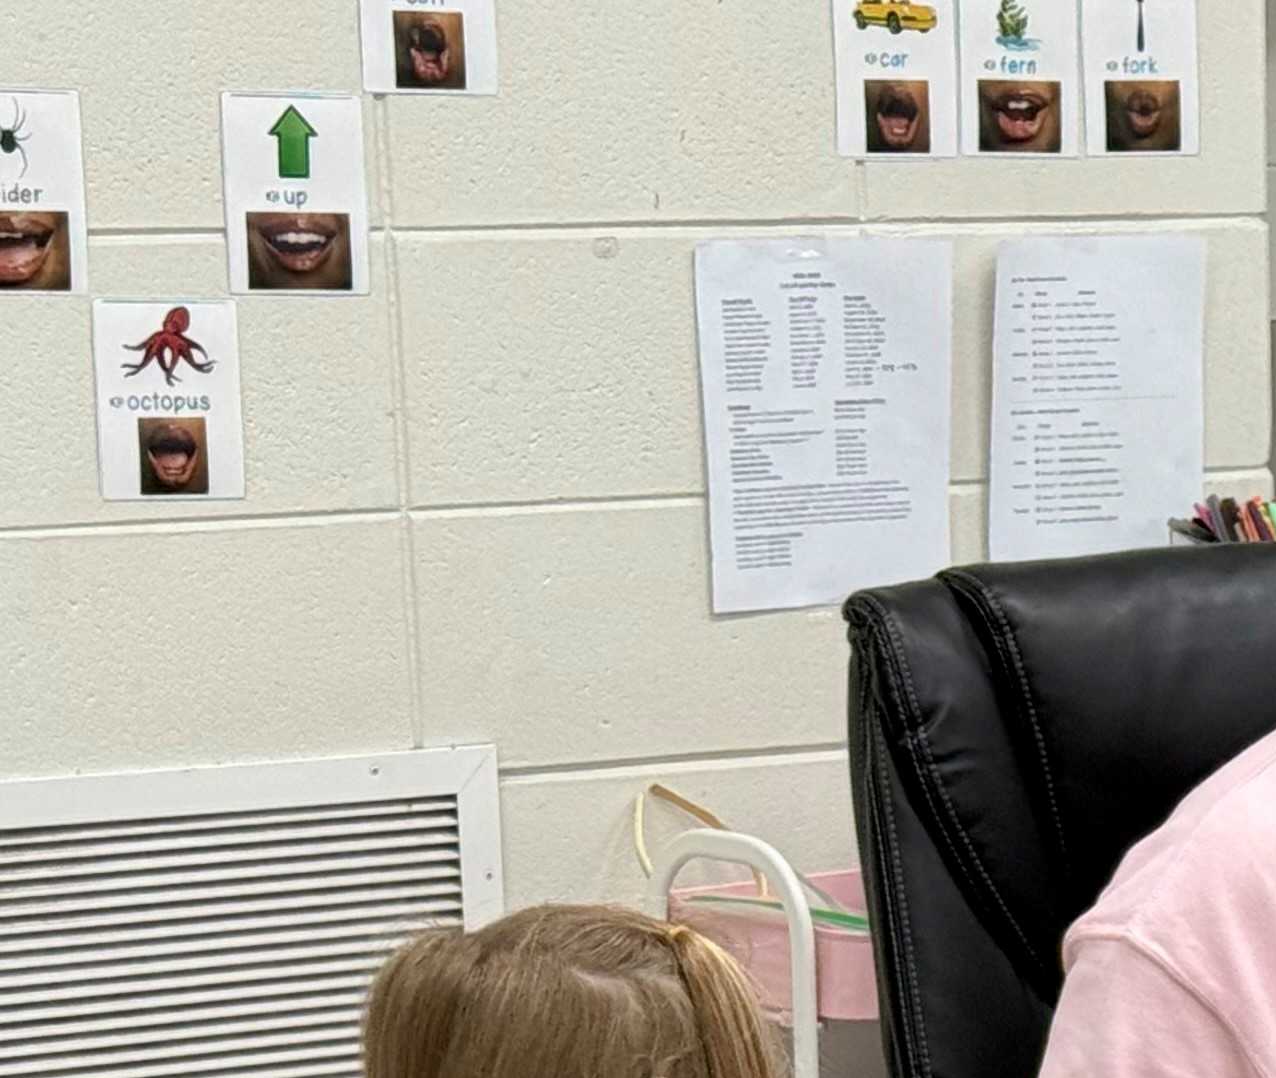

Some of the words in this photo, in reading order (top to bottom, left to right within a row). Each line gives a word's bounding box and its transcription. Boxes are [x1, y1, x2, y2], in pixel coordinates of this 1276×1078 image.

[879, 51, 910, 67] car
[1000, 58, 1037, 74] fern
[1122, 57, 1159, 74] fork
[283, 190, 308, 209] up
[127, 392, 211, 414] octopus
